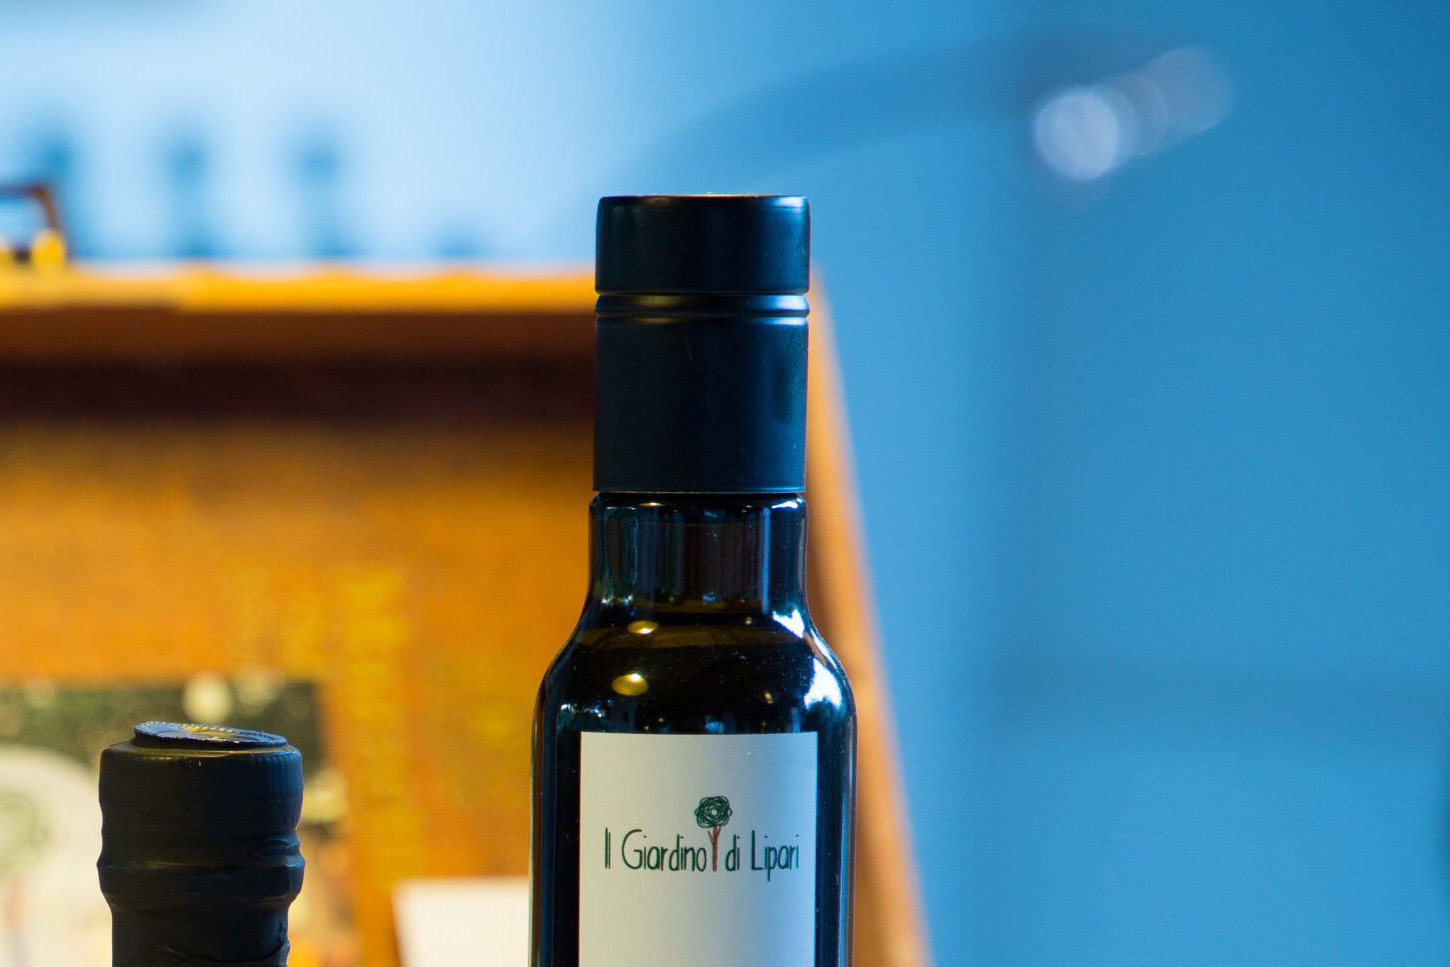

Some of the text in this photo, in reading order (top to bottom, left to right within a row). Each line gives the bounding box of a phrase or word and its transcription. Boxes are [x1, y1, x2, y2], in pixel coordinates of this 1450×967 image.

[621, 829, 707, 872] Giardino
[725, 833, 740, 871] di
[751, 830, 799, 882] Lipari
